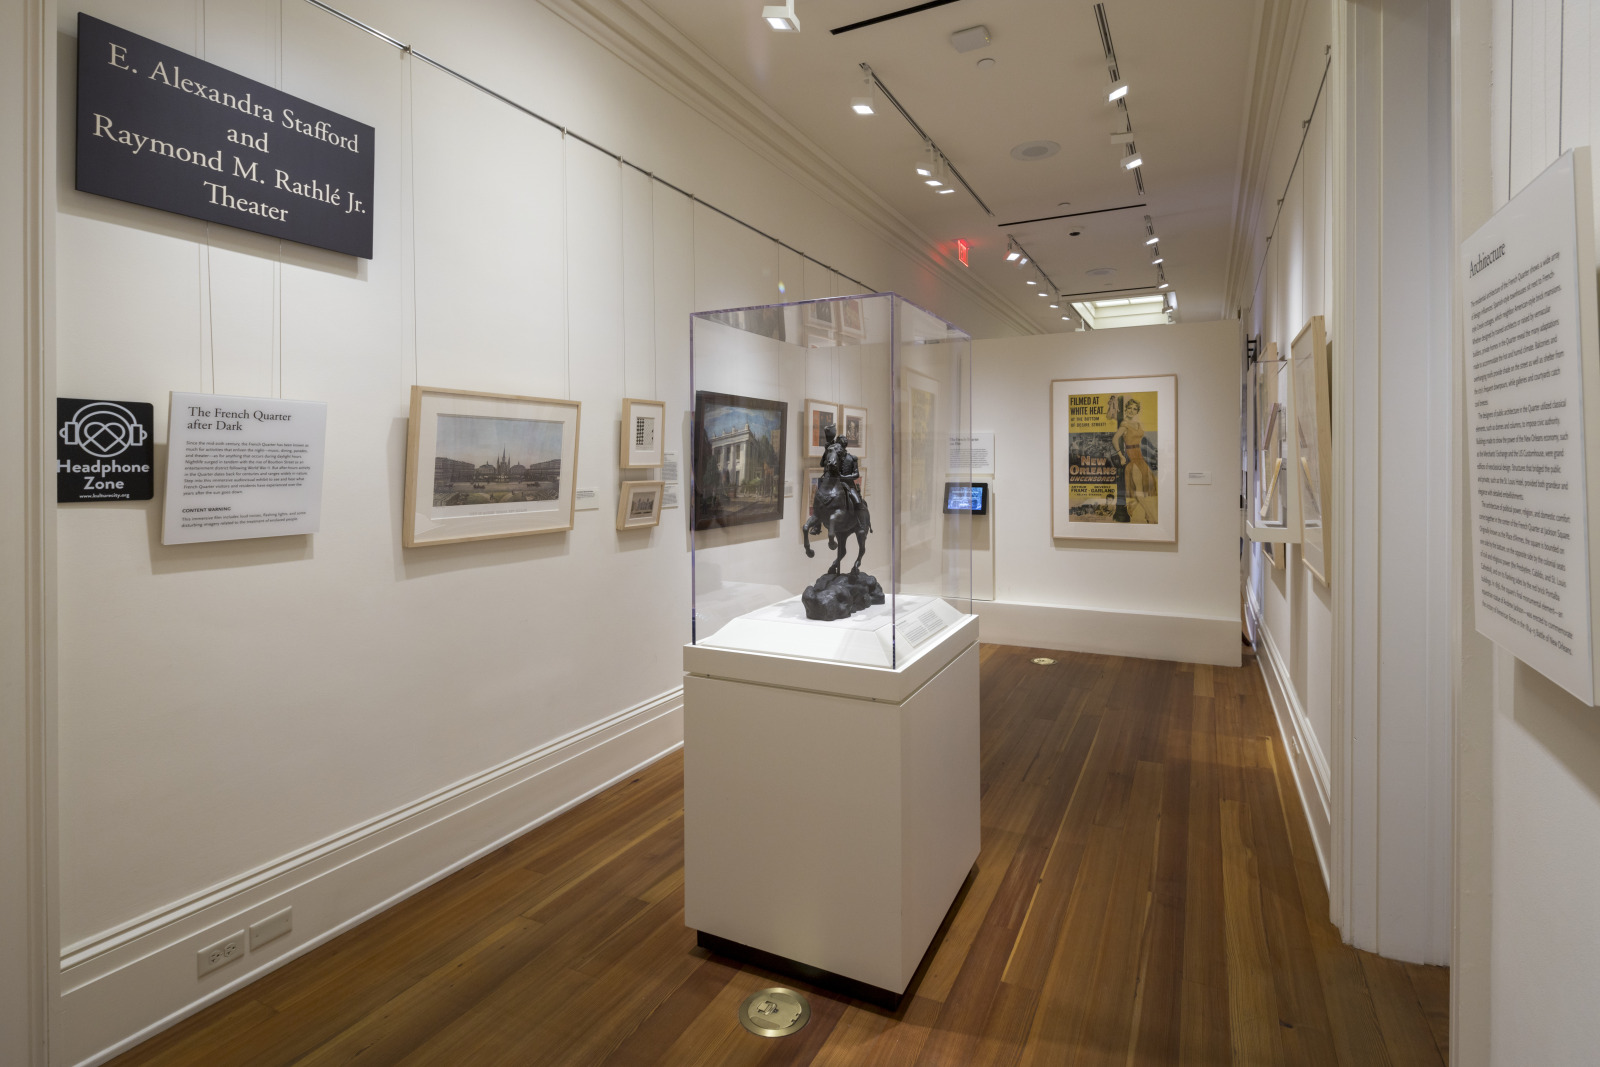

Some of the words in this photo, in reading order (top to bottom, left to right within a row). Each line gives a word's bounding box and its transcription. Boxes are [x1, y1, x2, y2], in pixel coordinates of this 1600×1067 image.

[107, 42, 138, 74] E.
[148, 61, 274, 123] Alexandra
[282, 109, 360, 154] Stafford
[226, 128, 270, 154] and
[92, 113, 224, 173] Raymond
[232, 156, 265, 184] M.
[274, 168, 340, 206] Rathlé
[345, 191, 366, 214] Jr.
[203, 180, 289, 222] Theater
[1469, 243, 1506, 278] Architecture
[1070, 397, 1091, 406] FILMED
[1093, 396, 1099, 405] AT
[188, 406, 211, 418] The
[214, 408, 250, 419] French
[254, 410, 292, 422] Quarter
[1070, 407, 1088, 416] WHITE
[187, 419, 212, 430] after
[216, 421, 242, 431] Dark
[57, 459, 150, 478] Headphone
[1081, 455, 1106, 466] NEW
[1070, 465, 1117, 475] ORLEANS
[84, 476, 124, 490] Zone
